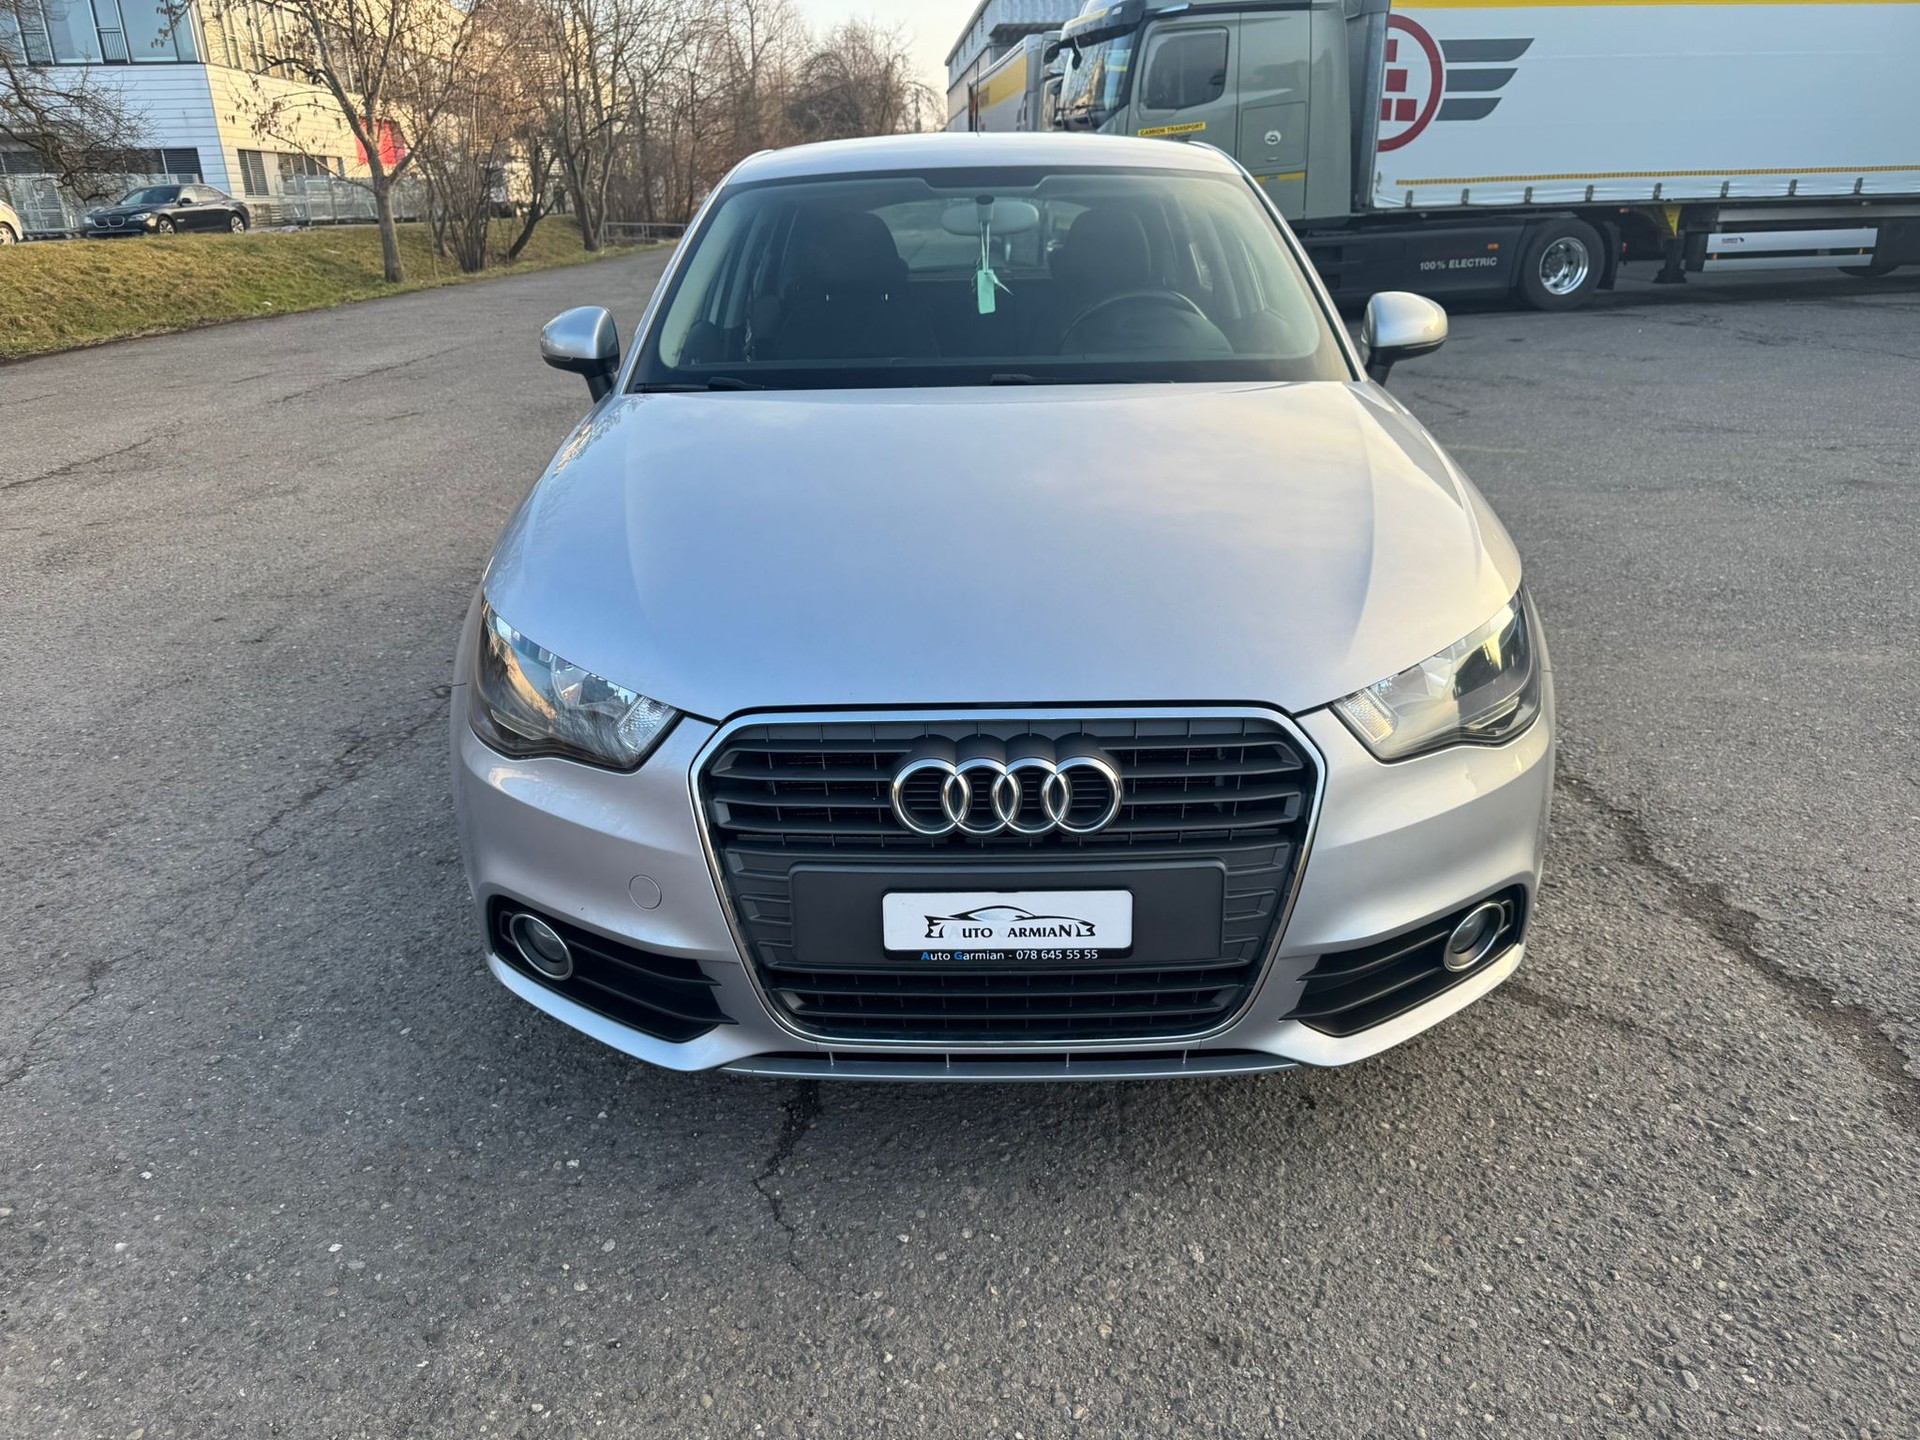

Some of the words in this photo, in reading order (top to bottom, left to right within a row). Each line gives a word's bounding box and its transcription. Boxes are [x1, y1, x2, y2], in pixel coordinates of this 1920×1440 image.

[1140, 127, 1165, 136] CAMION
[1167, 123, 1204, 132] TRANSPORT
[1448, 257, 1498, 269] ELECTRIC
[921, 951, 951, 961] Auto
[954, 950, 1004, 961] Garmian
[1016, 950, 1038, 960] 078
[1041, 950, 1062, 960] 645
[1066, 949, 1081, 960] 55
[1084, 949, 1098, 960] 55
